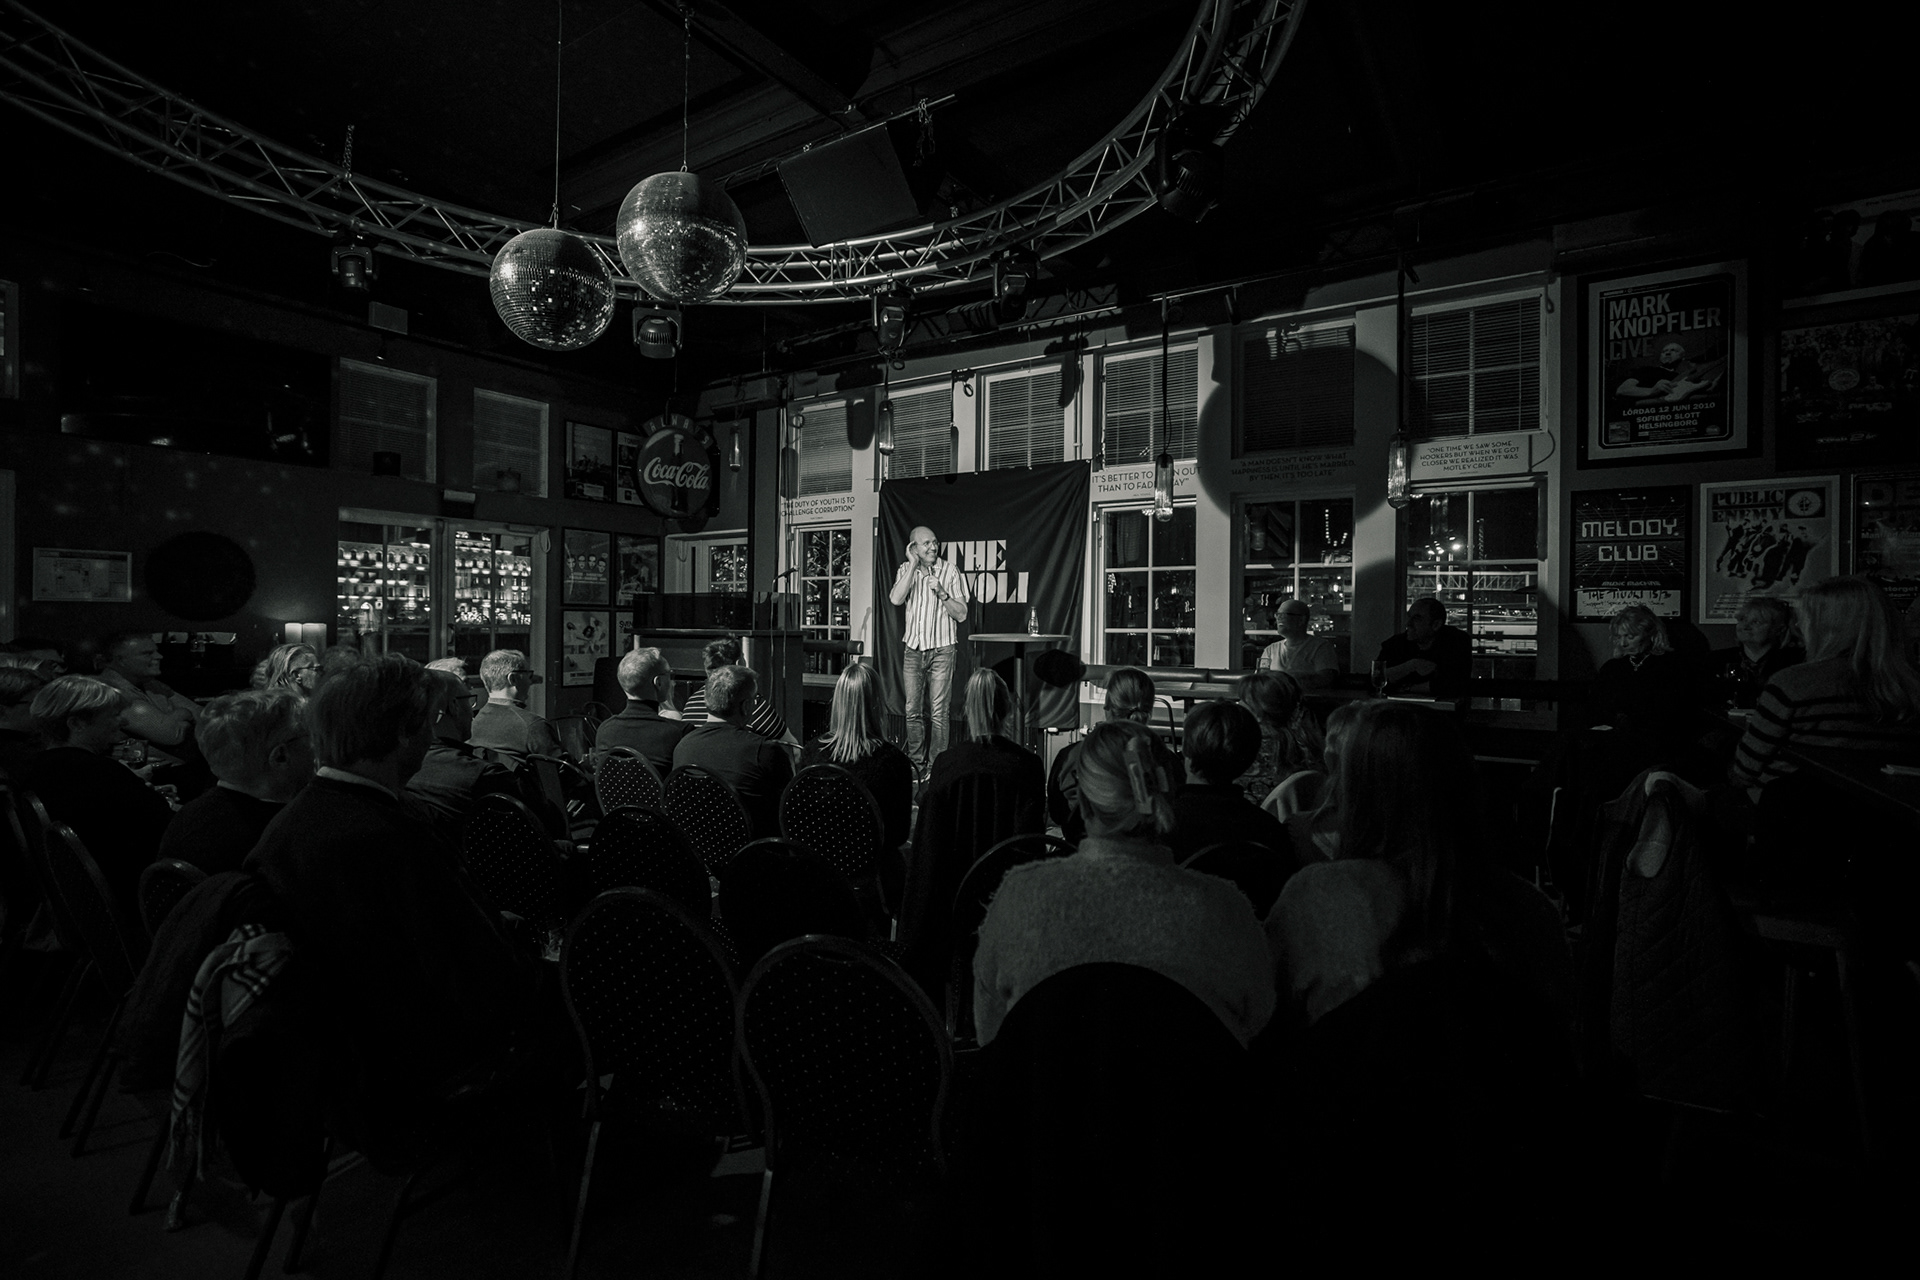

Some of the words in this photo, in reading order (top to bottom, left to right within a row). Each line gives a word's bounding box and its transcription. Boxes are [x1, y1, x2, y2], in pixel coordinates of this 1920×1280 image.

[1609, 293, 1671, 320] MARK
[1609, 307, 1721, 340] KNOPFLER
[1610, 336, 1655, 361] LIVE
[1671, 404, 1691, 412] JUNI
[1694, 401, 1716, 410] 2010
[1636, 413, 1672, 424] SOFIERO
[1674, 411, 1701, 420] SLOTT
[1638, 419, 1699, 430] HELSINGBORG
[1266, 457, 1297, 465] DOESN'T
[643, 456, 711, 490] Coca-Cola
[1107, 472, 1140, 482] BETTER
[1142, 471, 1154, 479] TO
[1231, 466, 1271, 475] HAPPINESS
[1098, 484, 1121, 493] THAN
[1122, 483, 1135, 491] TO
[1712, 489, 1784, 506] PUBLIC
[1712, 508, 1784, 523] ENEMY
[1582, 518, 1678, 538] MELODY
[940, 539, 1007, 571] THE
[1598, 544, 1659, 562] CLUB
[1585, 589, 1604, 601] THE
